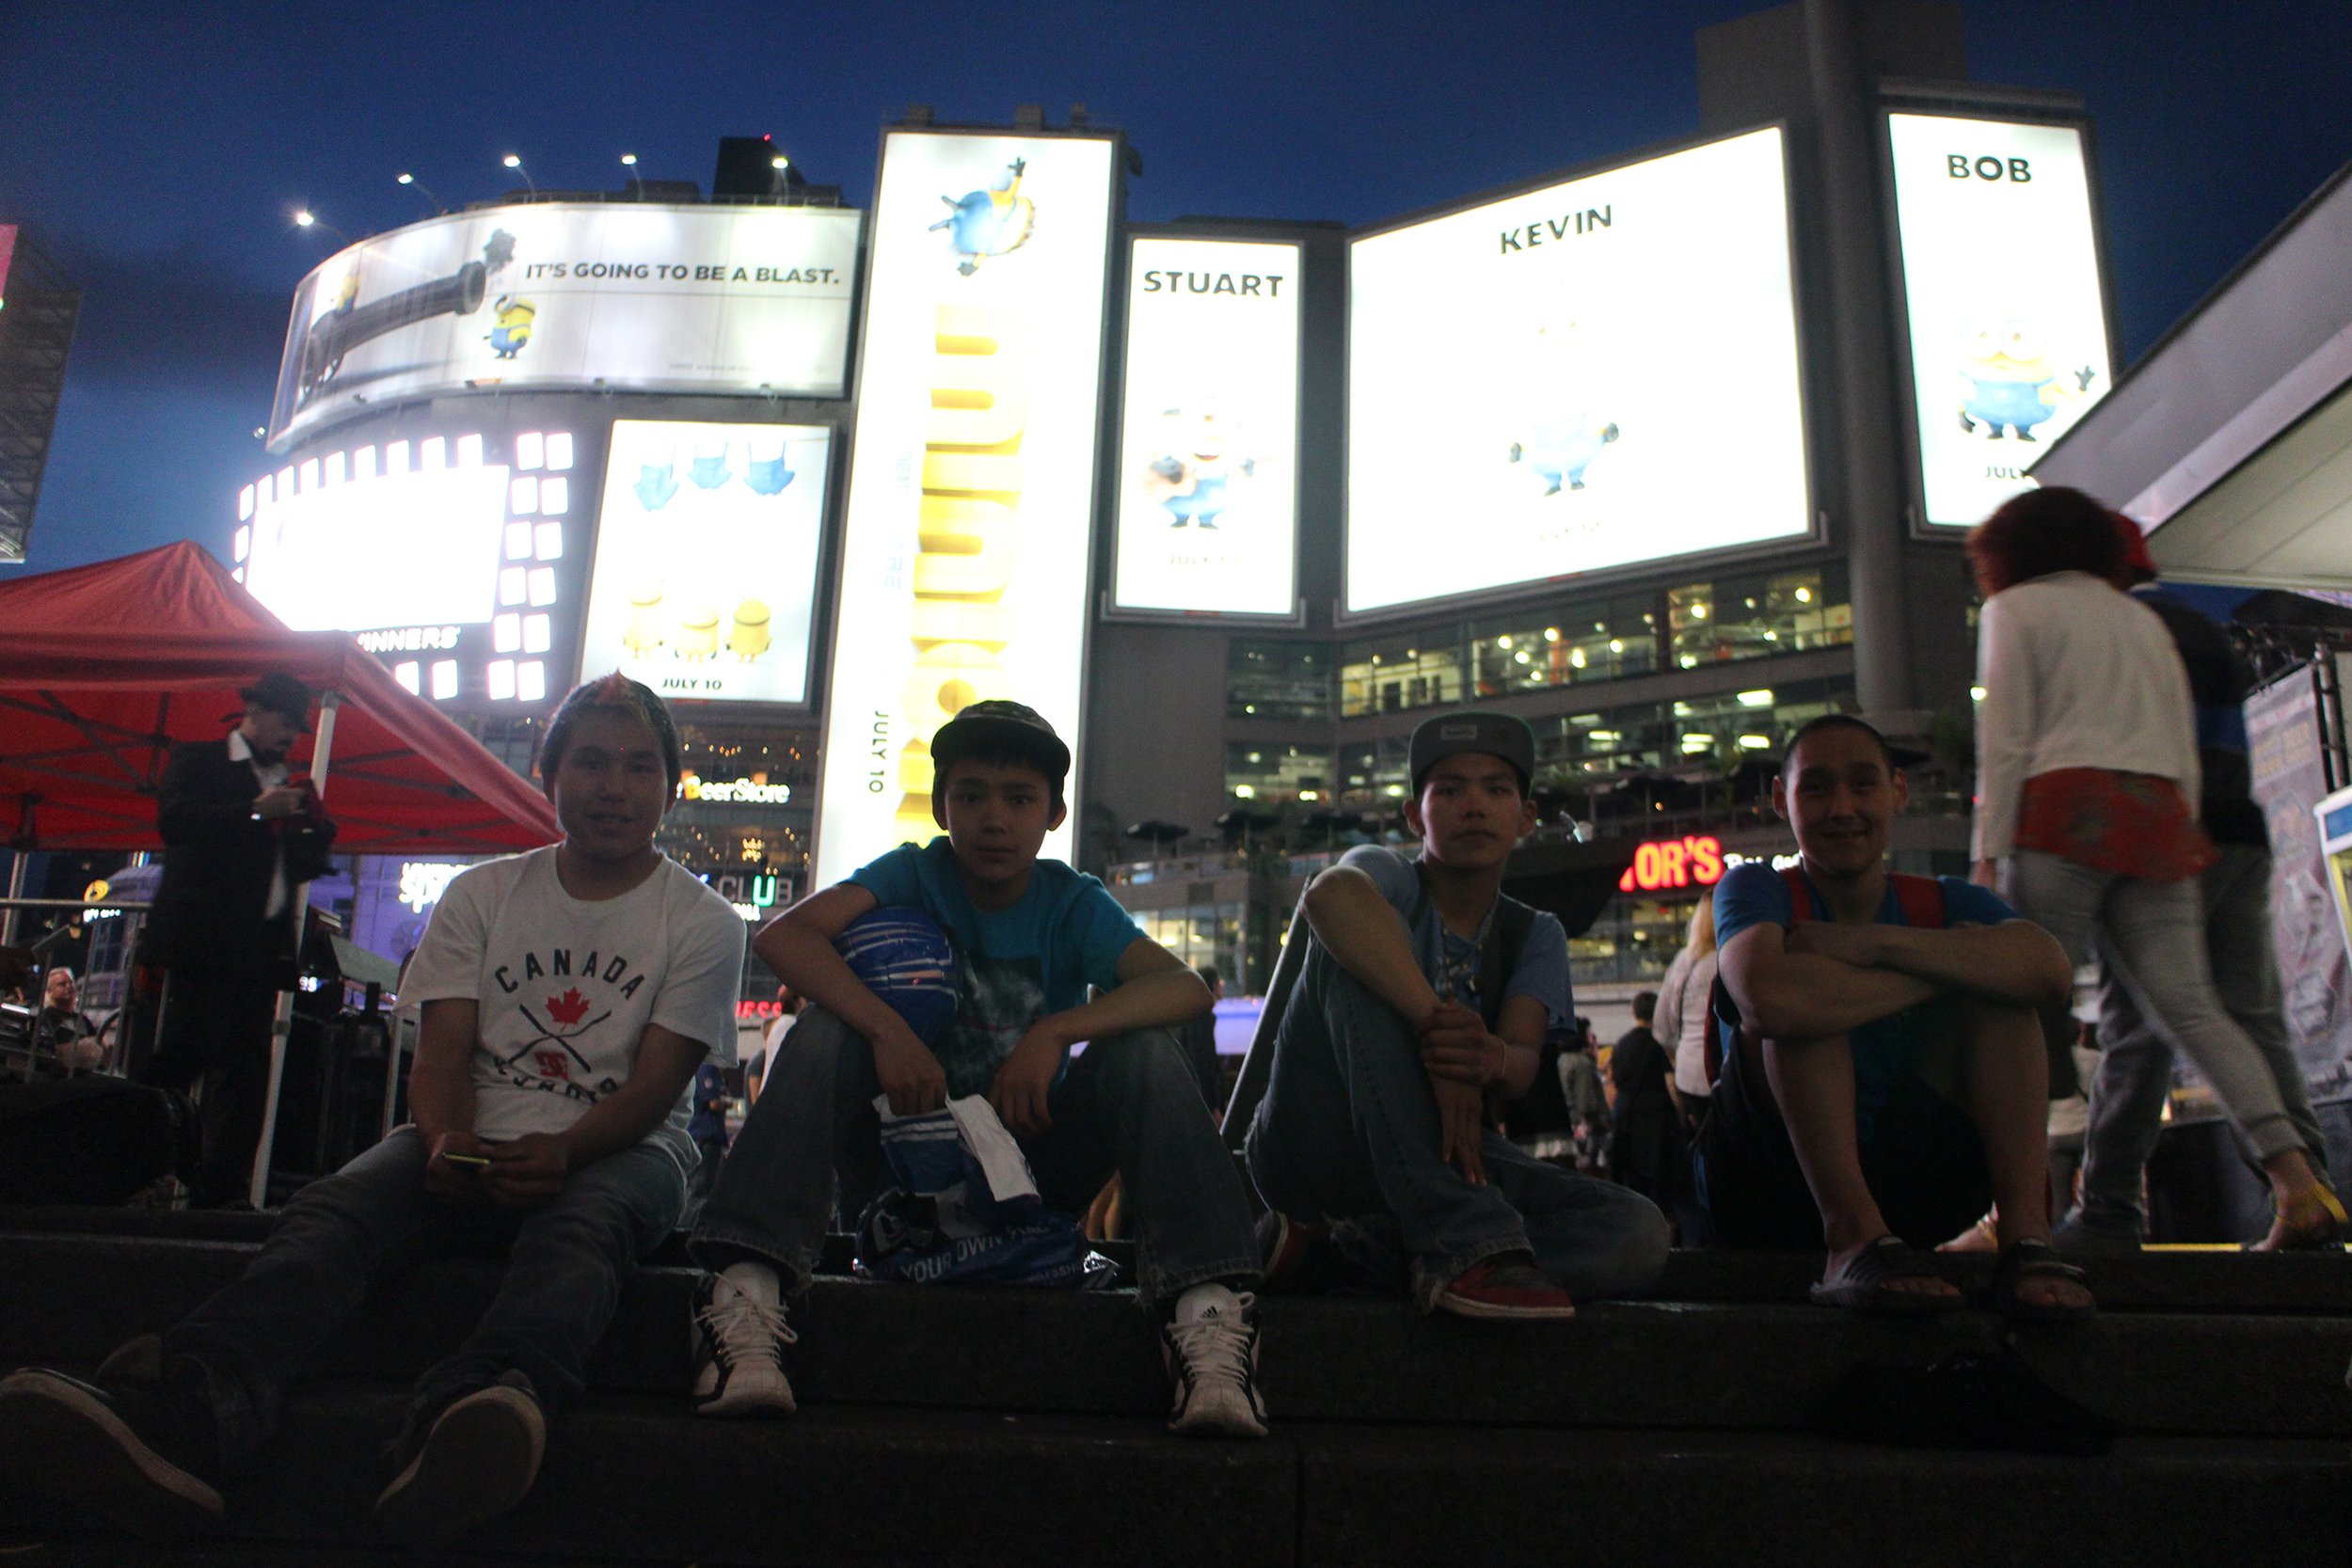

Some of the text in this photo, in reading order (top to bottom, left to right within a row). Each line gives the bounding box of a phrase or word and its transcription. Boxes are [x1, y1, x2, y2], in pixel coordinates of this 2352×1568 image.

[1947, 154, 2033, 183] BOB
[1501, 204, 1612, 255] KEVIN
[525, 262, 840, 284] IT'S GOING TO BE A BLAST.
[1143, 269, 1284, 297] STUART
[661, 677, 723, 690] JULY 10
[867, 709, 890, 794] JULY 10
[1619, 835, 1724, 892] OR'S
[718, 866, 793, 907] CLUB
[494, 948, 645, 1001] CANADA
[899, 1253, 952, 1284] YOUR
